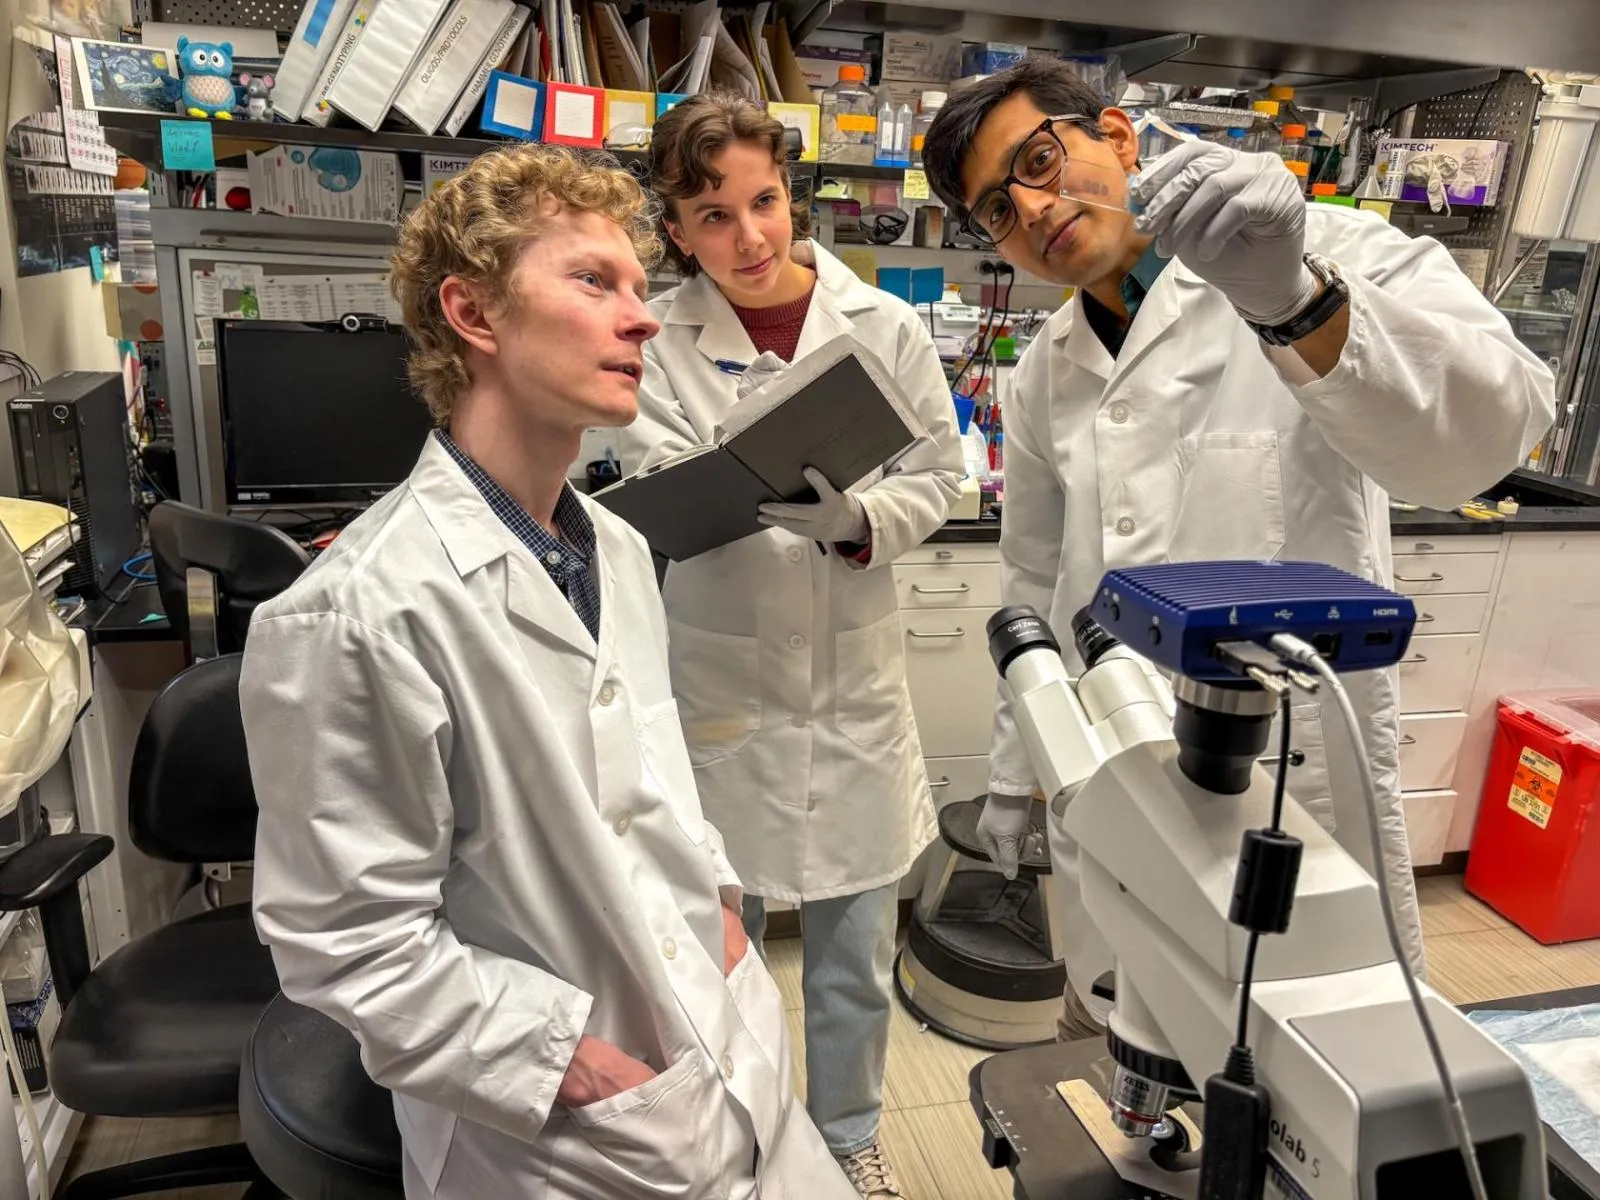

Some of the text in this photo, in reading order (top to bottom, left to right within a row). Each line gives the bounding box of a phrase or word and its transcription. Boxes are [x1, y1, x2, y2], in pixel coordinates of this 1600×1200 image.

[327, 33, 357, 86] GENOTYPING
[421, 14, 468, 84] OLIGOS/PROTOCOLS
[471, 16, 519, 96] HAMMER GENOTYPING
[1007, 622, 1023, 633] Carl
[1373, 608, 1399, 616] HDMI
[1310, 1157, 1321, 1179] 5
